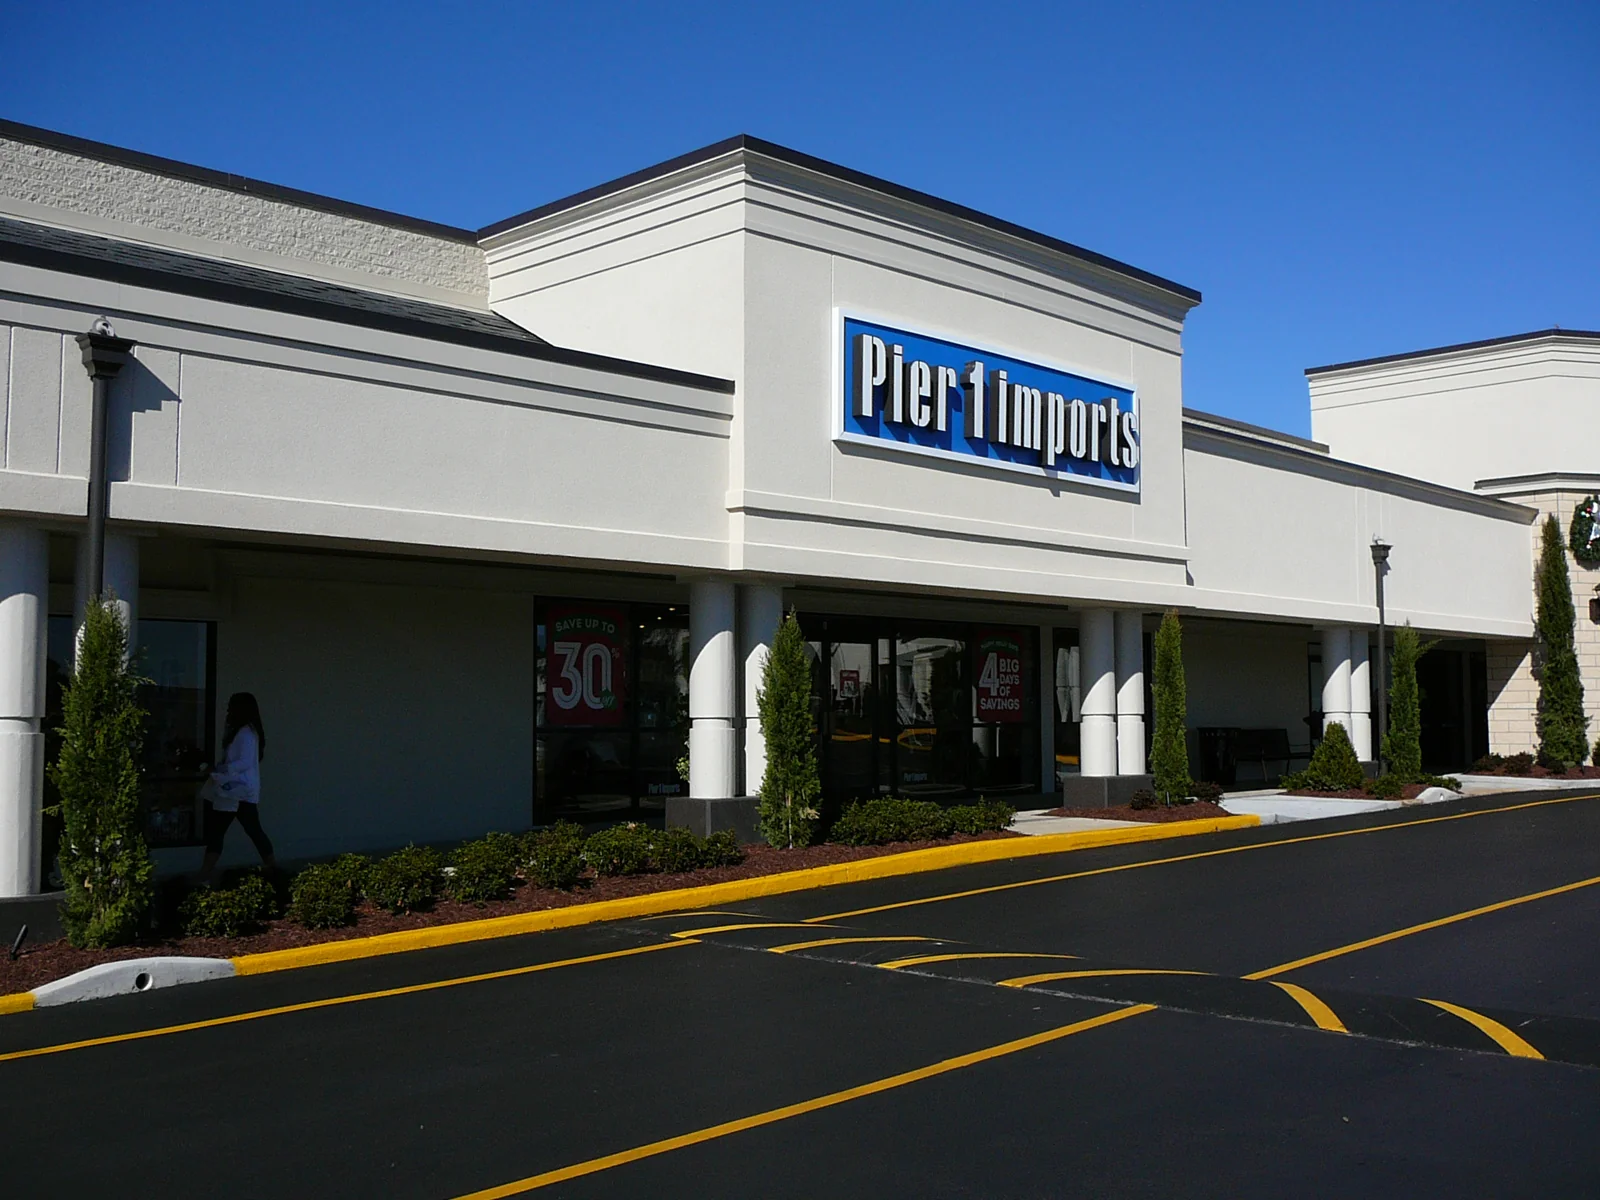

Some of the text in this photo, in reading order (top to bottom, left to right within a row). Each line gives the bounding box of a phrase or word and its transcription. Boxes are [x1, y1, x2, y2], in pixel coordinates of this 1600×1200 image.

[860, 333, 1138, 469] Pier 1 imports
[555, 618, 616, 634] SAVE UP TO
[999, 658, 1020, 673] BIG
[978, 652, 1000, 696] 4
[999, 674, 1020, 685] DAYS
[999, 686, 1011, 697] OF
[980, 698, 1020, 710] SAVINGS
